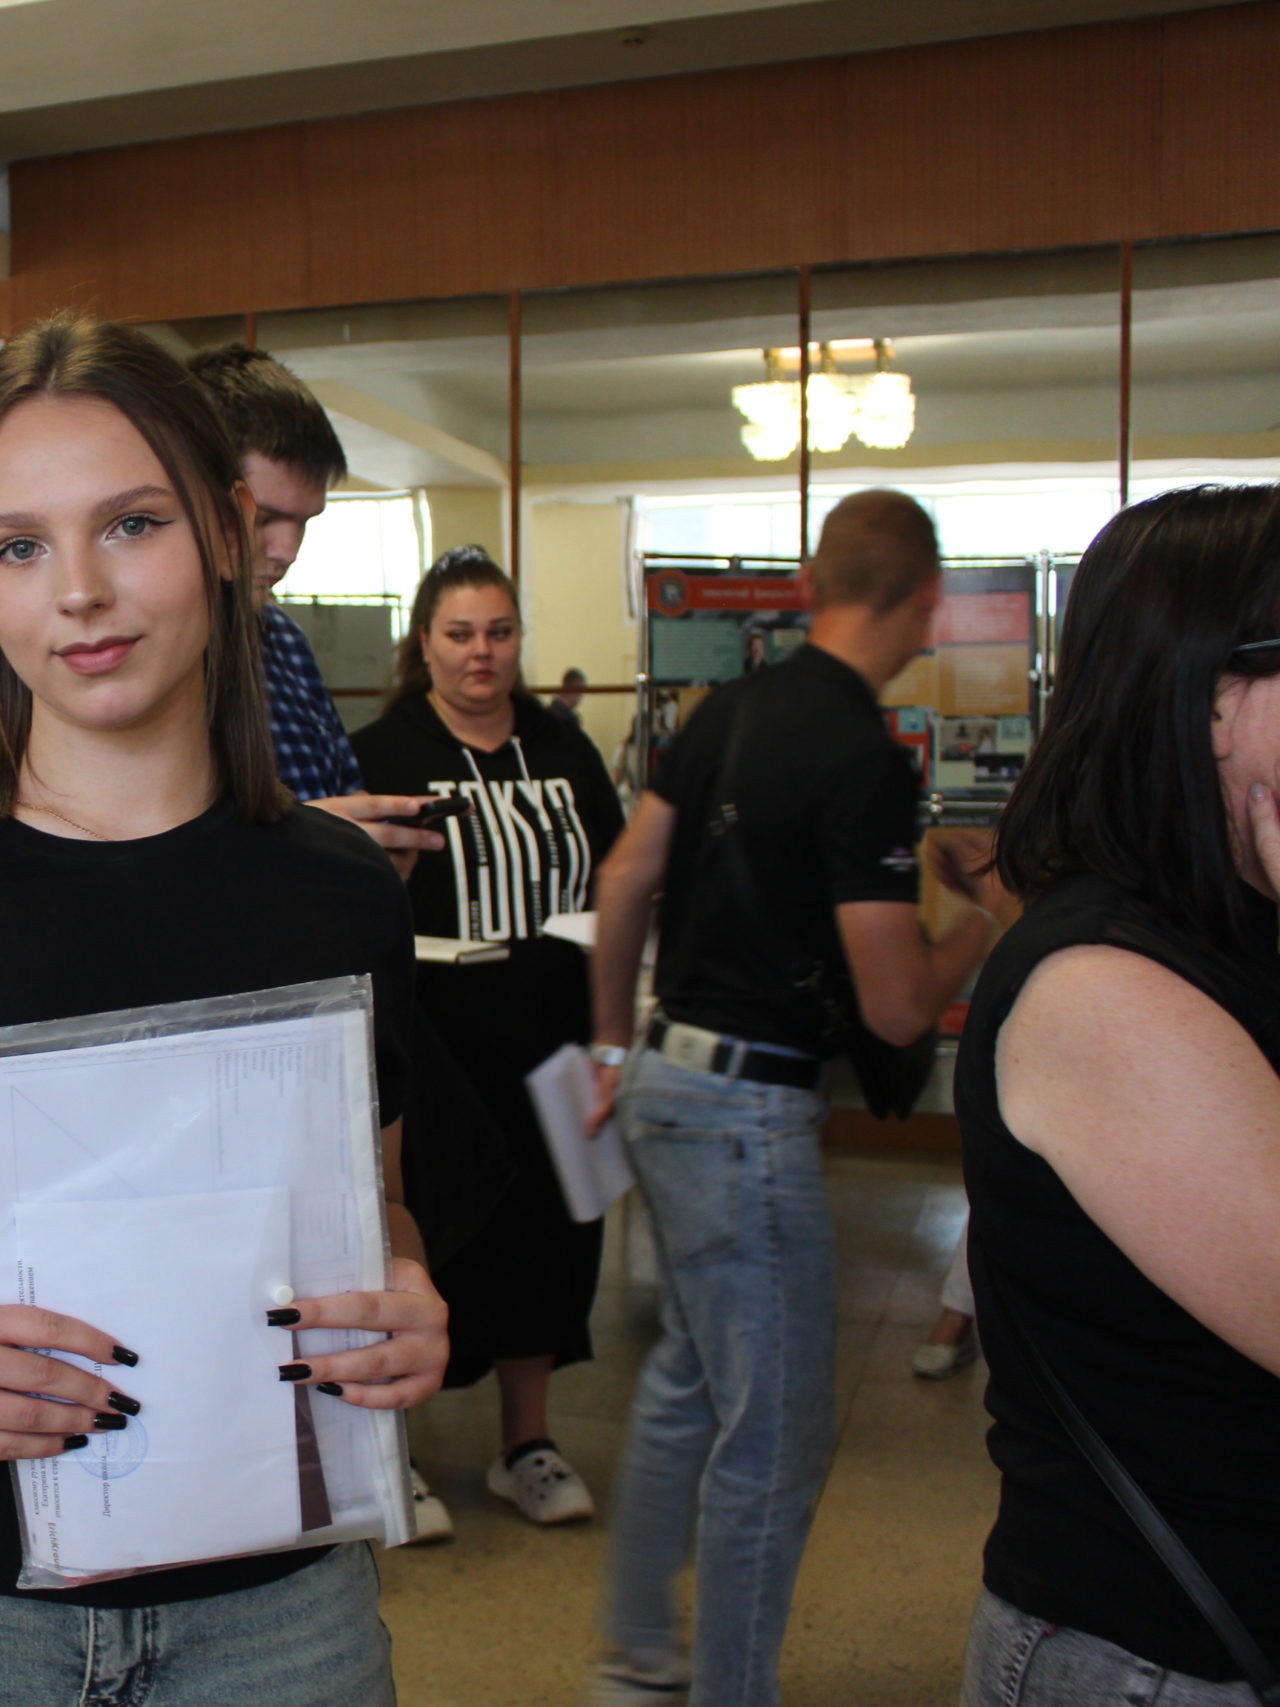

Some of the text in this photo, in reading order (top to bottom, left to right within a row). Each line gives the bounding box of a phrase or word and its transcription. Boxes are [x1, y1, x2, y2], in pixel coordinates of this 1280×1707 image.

[427, 778, 591, 942] TOKYO
[41, 1470, 49, 1507] Екатерина
[102, 1482, 111, 1517] Директор
